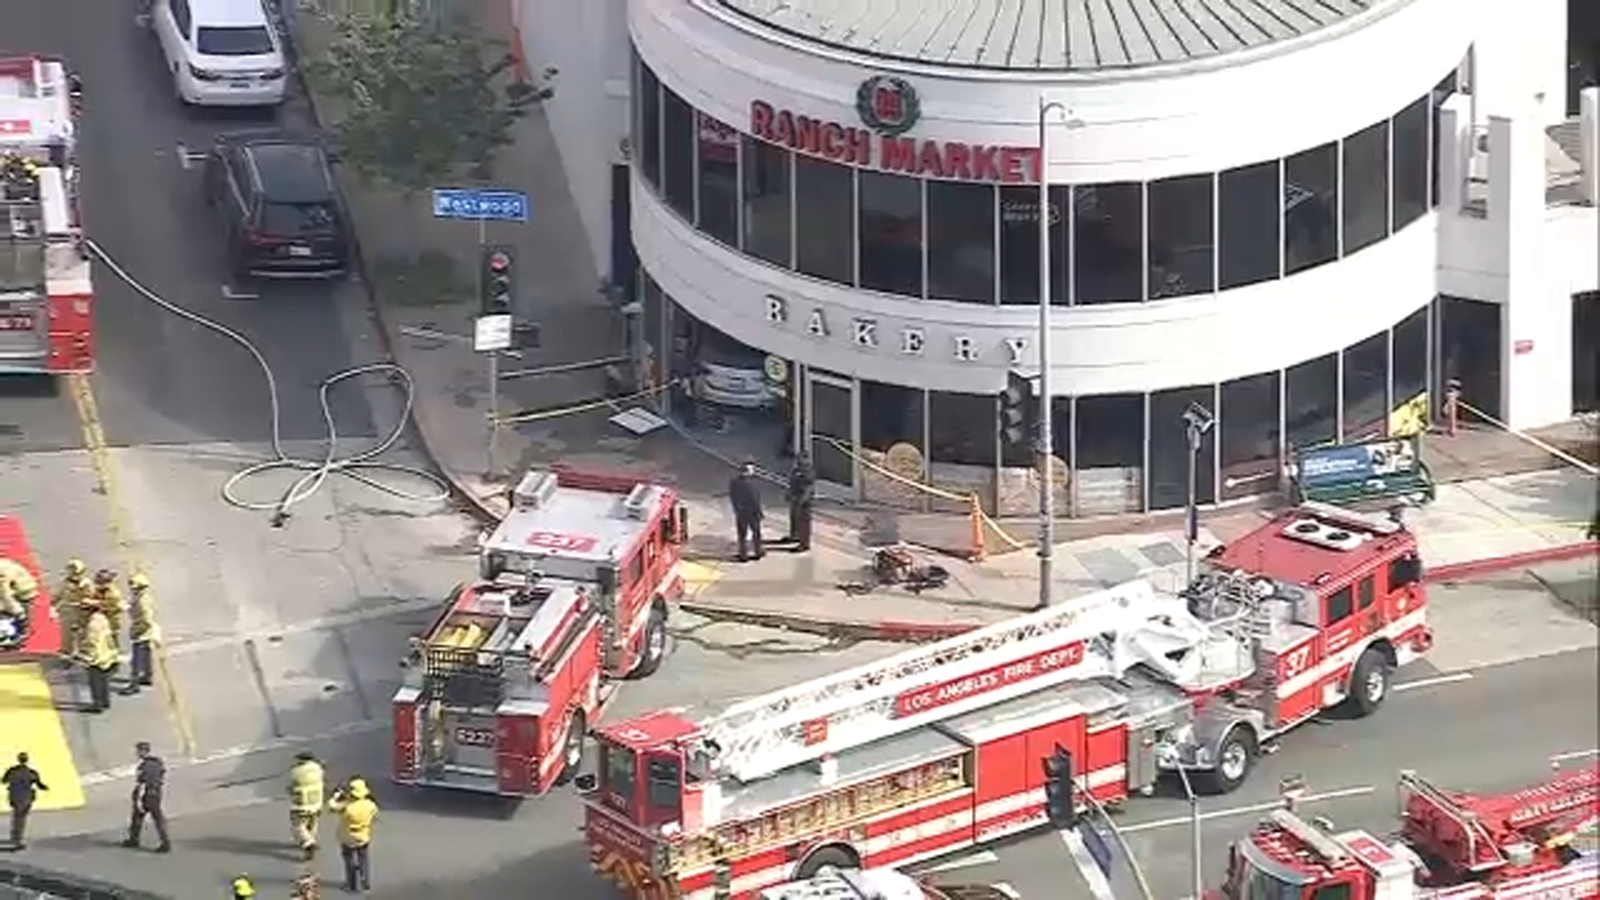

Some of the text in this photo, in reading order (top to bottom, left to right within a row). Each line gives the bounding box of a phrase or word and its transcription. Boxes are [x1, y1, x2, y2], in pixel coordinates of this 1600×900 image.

[751, 100, 870, 165] RANCH
[879, 137, 1042, 182] MARKET
[904, 691, 932, 711] LOS
[936, 672, 1000, 701] ANGELES
[1002, 660, 1036, 680] FIRE
[1285, 645, 1310, 676] 37
